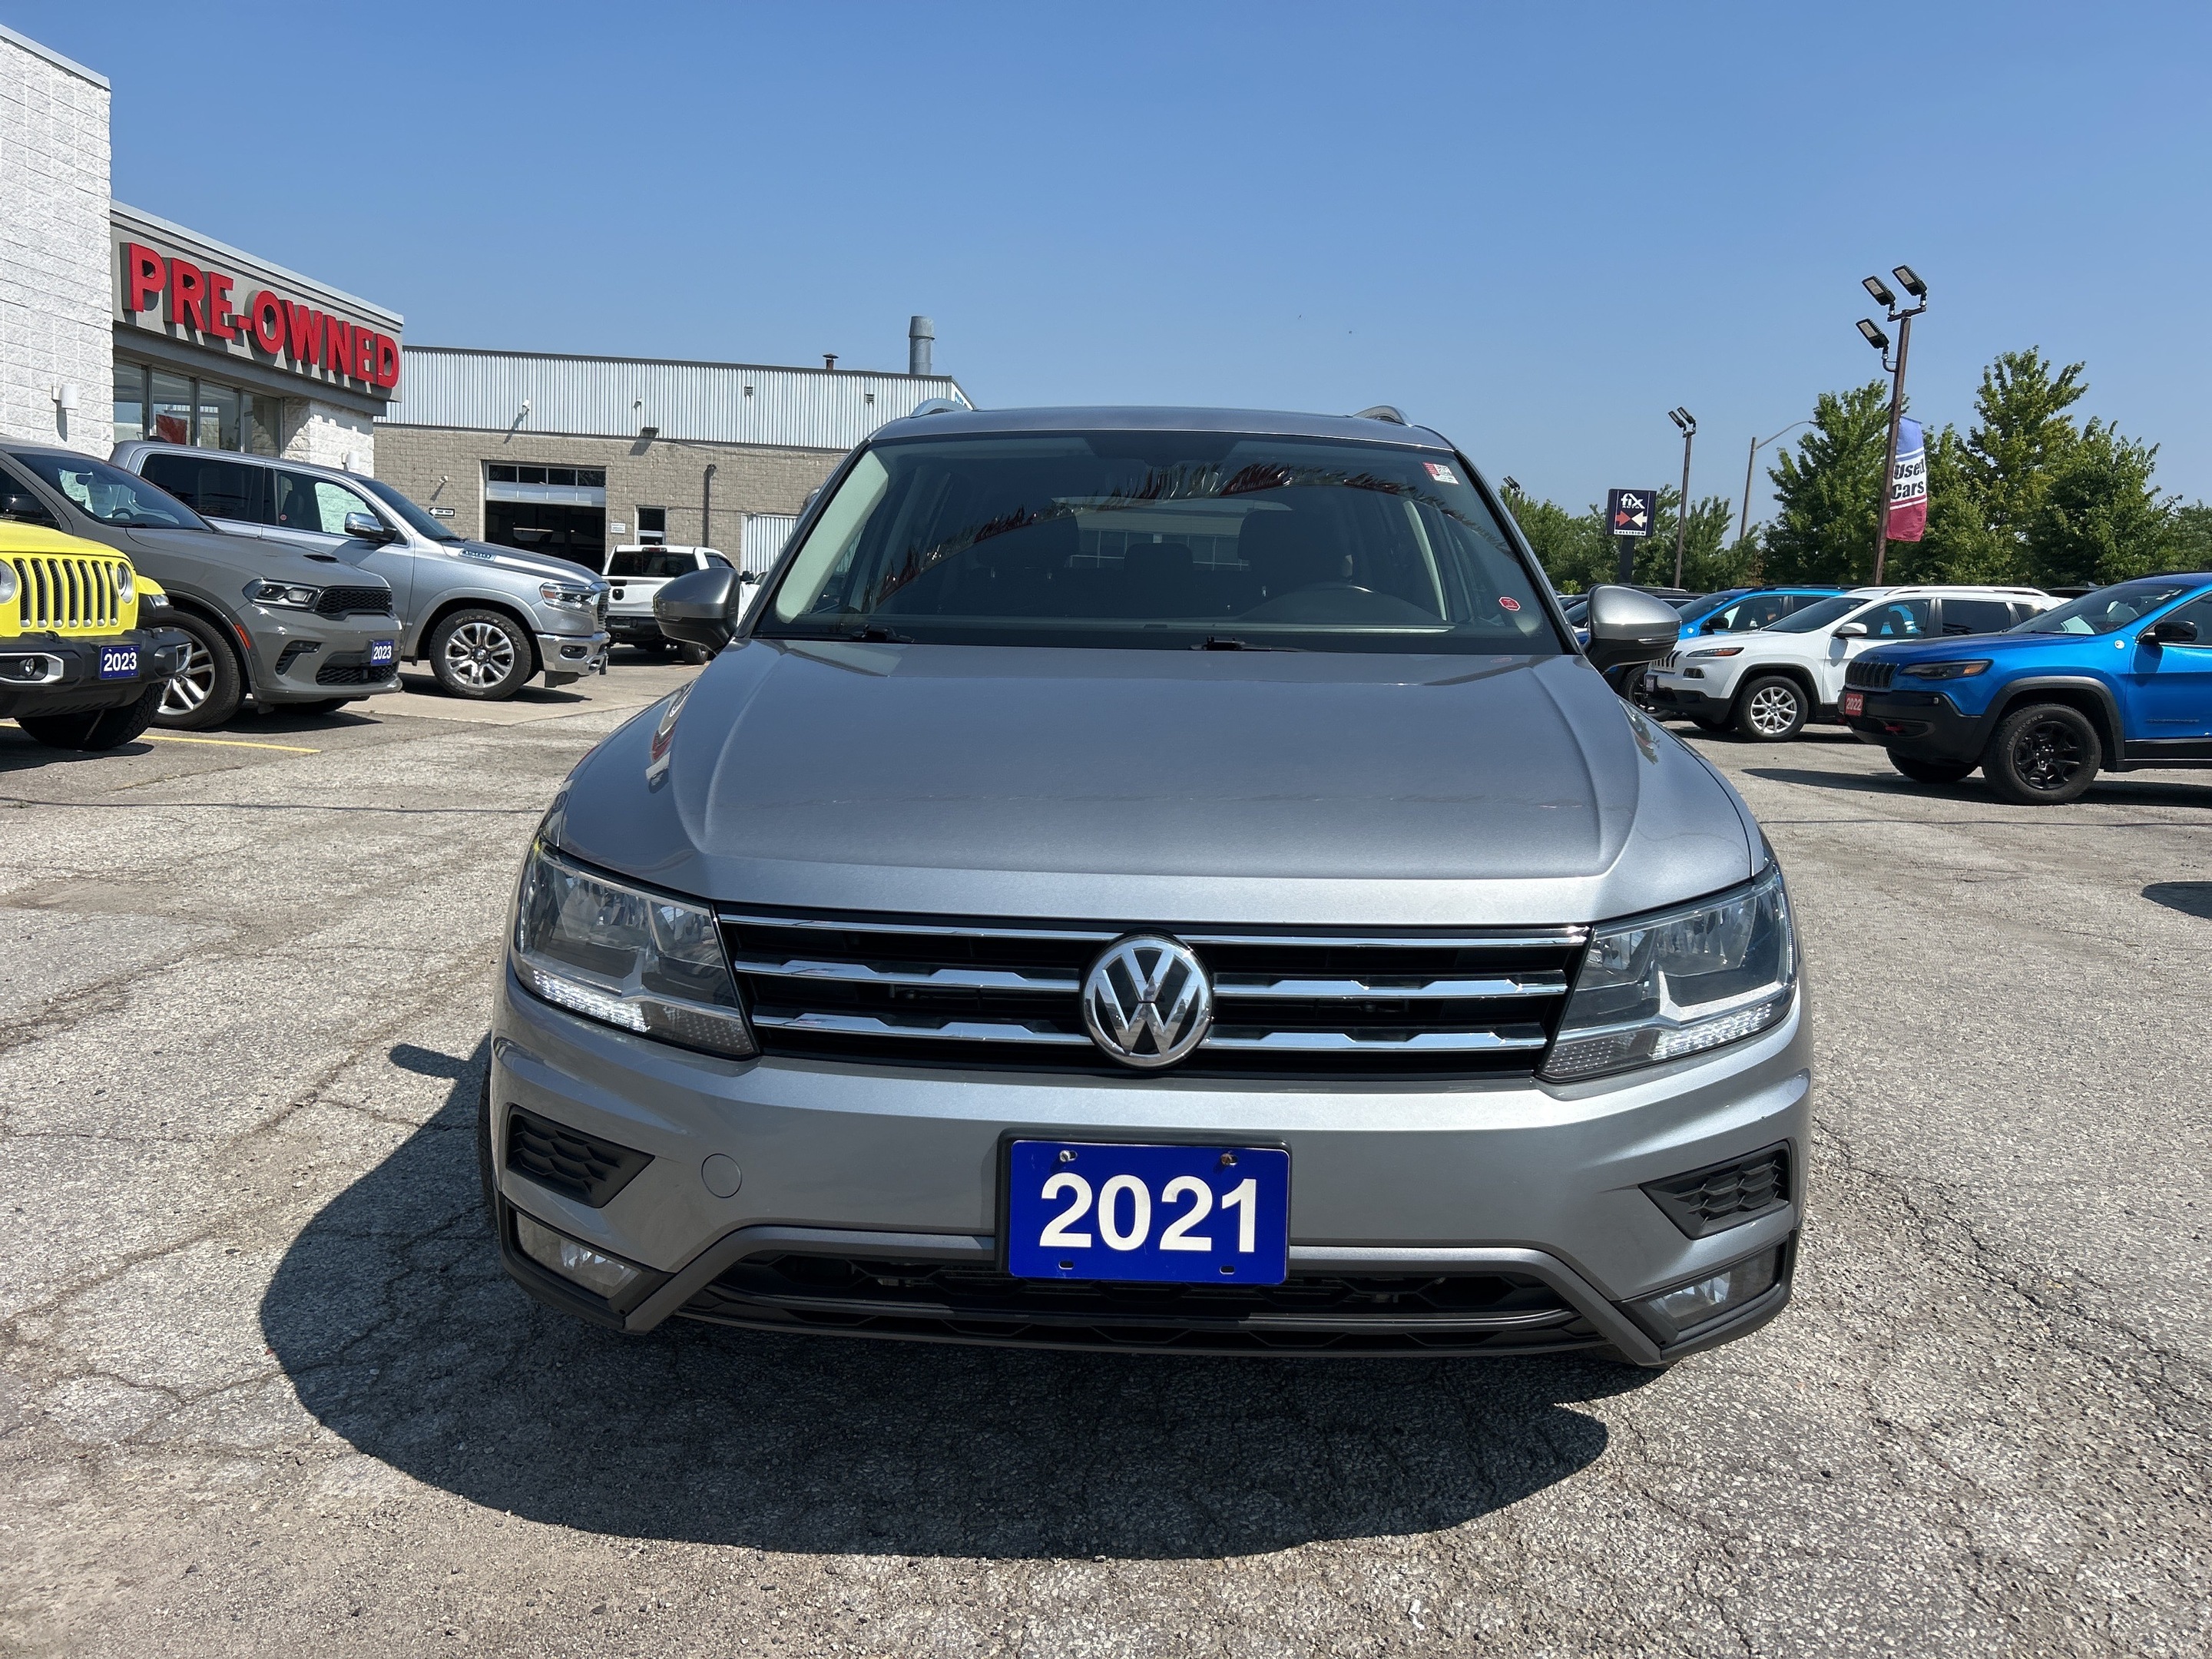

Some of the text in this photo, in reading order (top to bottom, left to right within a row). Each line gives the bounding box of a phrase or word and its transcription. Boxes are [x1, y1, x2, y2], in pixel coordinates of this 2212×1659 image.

[127, 243, 400, 388] PRE-OWNED
[1893, 458, 1925, 480] Used
[1891, 481, 1925, 499] Cars
[1621, 492, 1645, 509] fix
[103, 651, 137, 672] 2023
[373, 645, 392, 661] 2023
[1846, 697, 1862, 711] 2022
[1039, 1172, 1257, 1253] 2021
